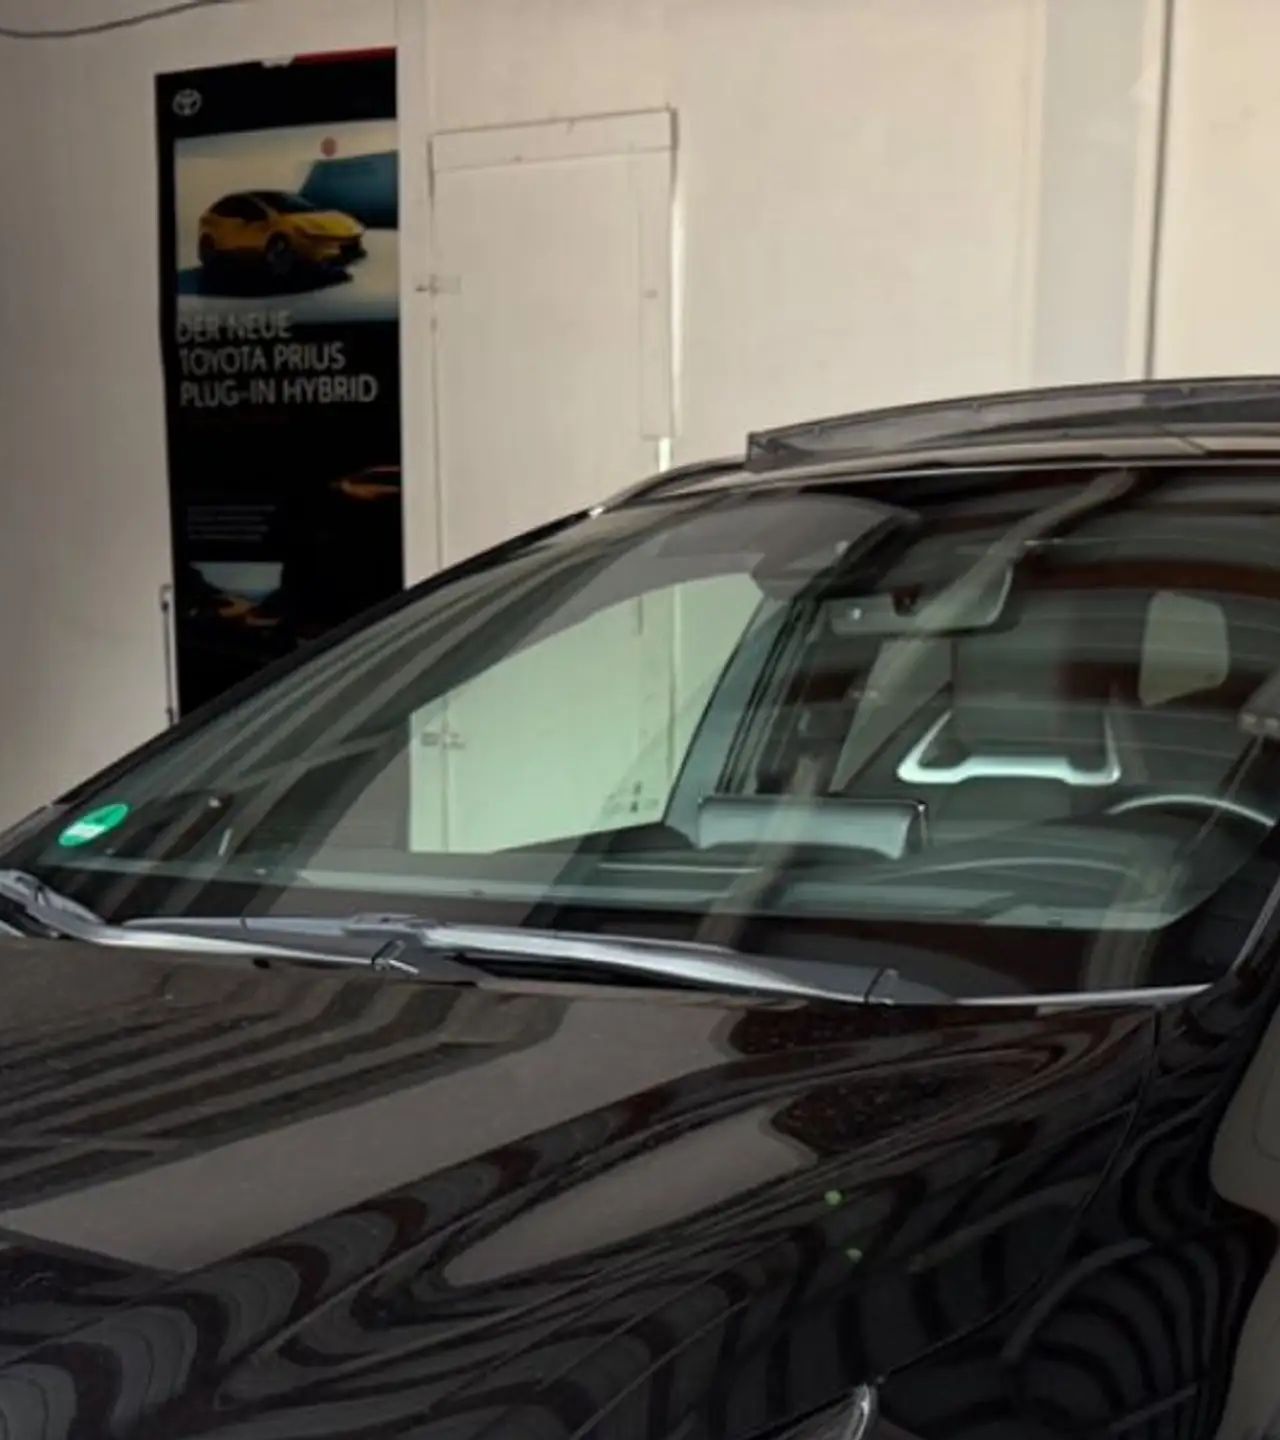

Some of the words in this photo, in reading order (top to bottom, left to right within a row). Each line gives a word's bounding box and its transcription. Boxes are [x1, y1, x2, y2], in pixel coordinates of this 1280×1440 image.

[176, 313, 221, 344] DER
[227, 310, 293, 340] NEUE
[179, 345, 268, 376] TOYOTA
[273, 340, 346, 372] PRIUS
[179, 378, 276, 408] PLUG-IN
[282, 373, 379, 404] HYBRID
